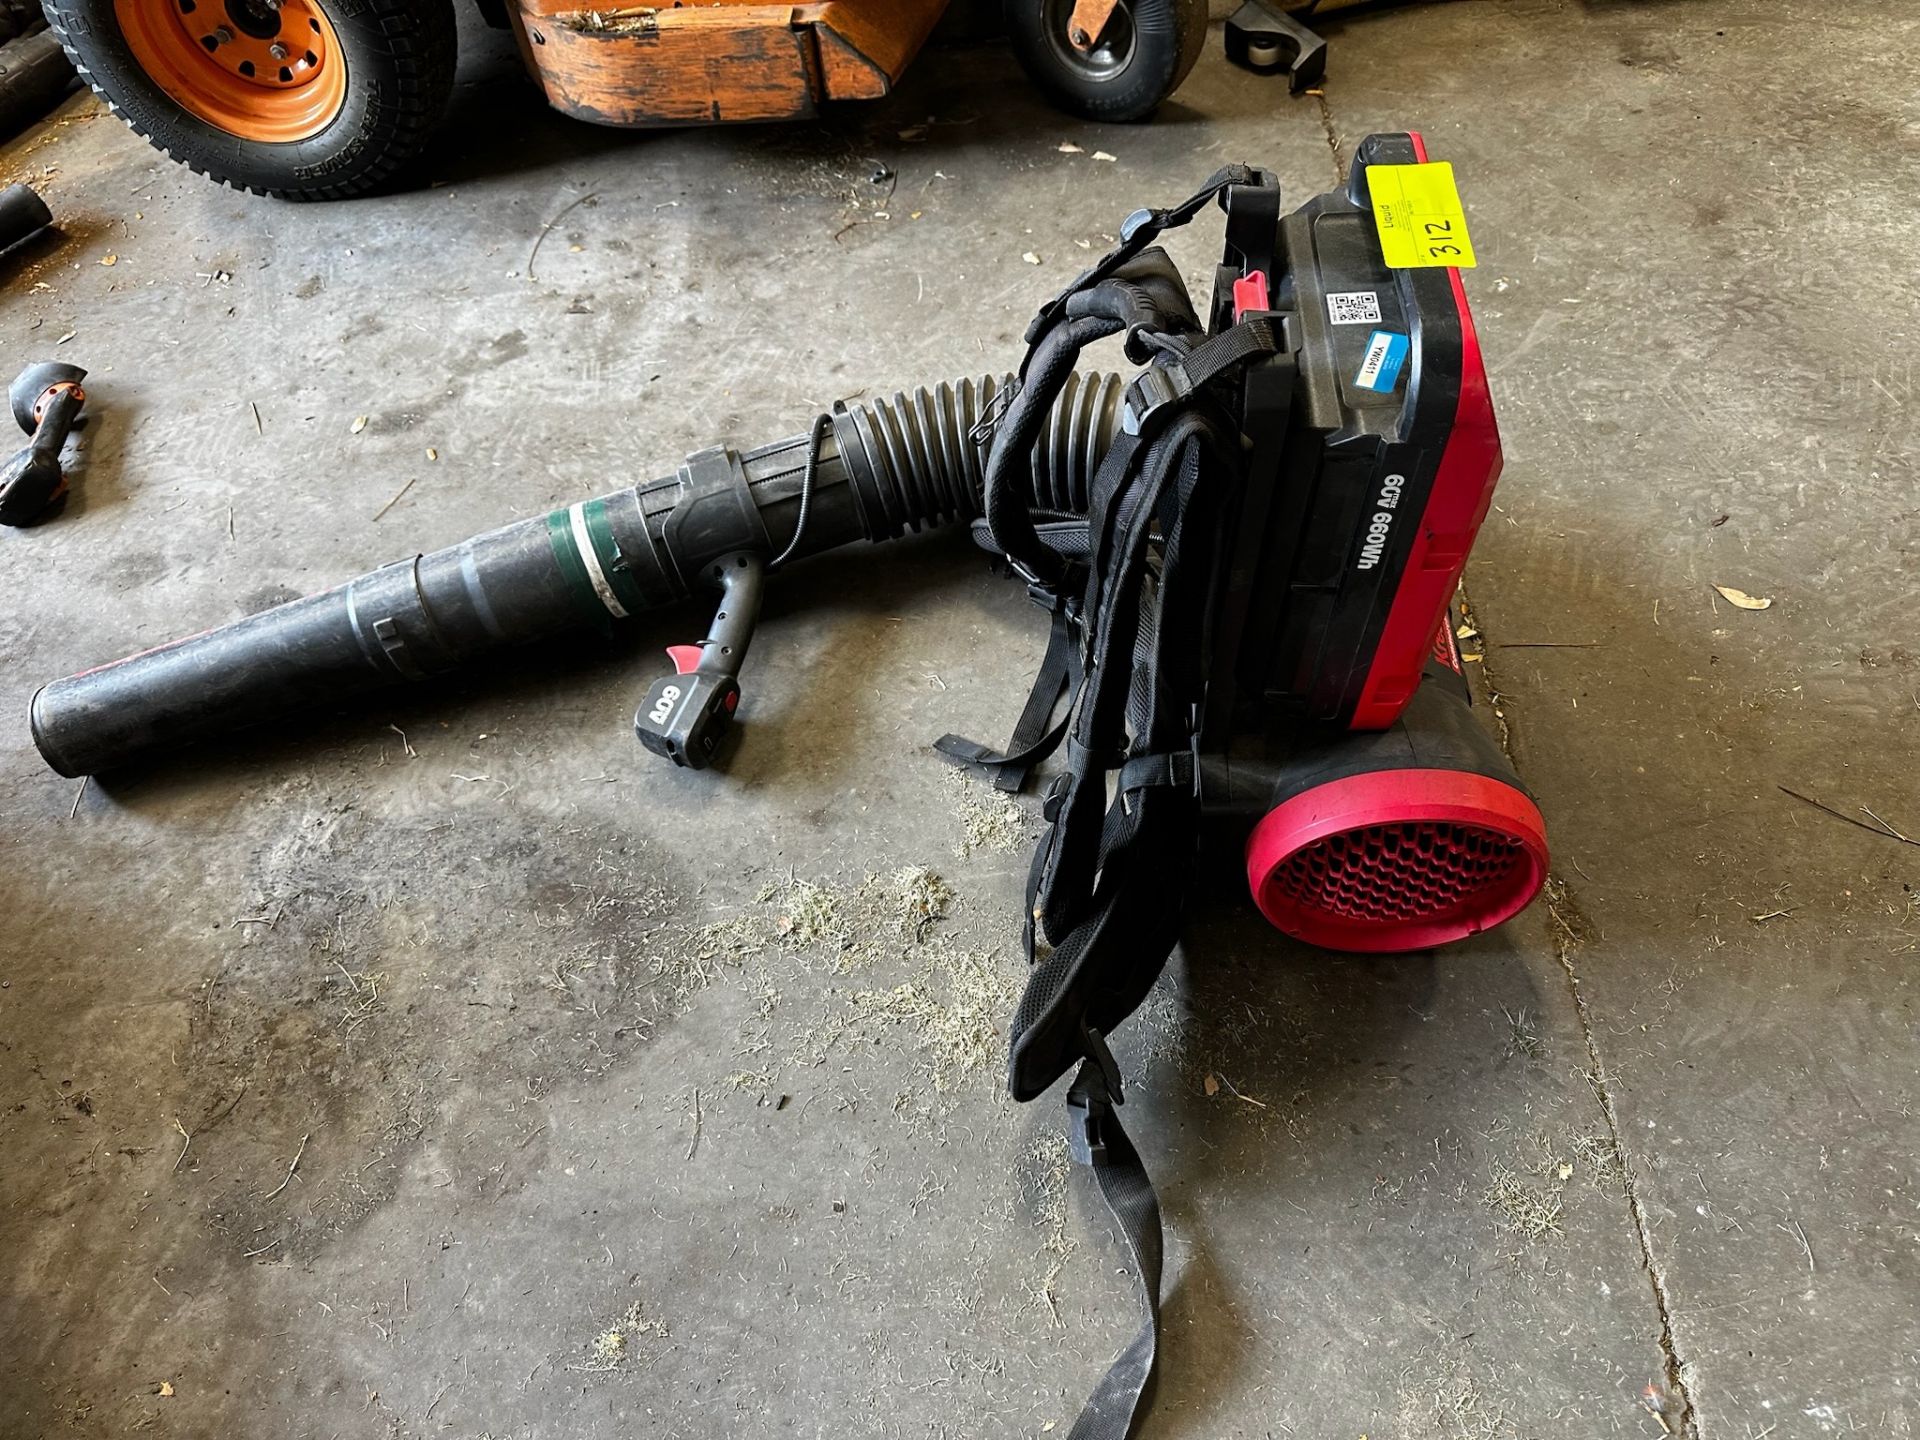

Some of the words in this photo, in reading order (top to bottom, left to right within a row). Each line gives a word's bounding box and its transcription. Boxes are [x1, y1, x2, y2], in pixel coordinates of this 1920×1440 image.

[1380, 204, 1394, 229] Liquid
[1424, 220, 1462, 258] 312
[1365, 346, 1385, 375] YW0411
[1357, 512, 1393, 570] 660Wh
[648, 685, 681, 726] 60V
